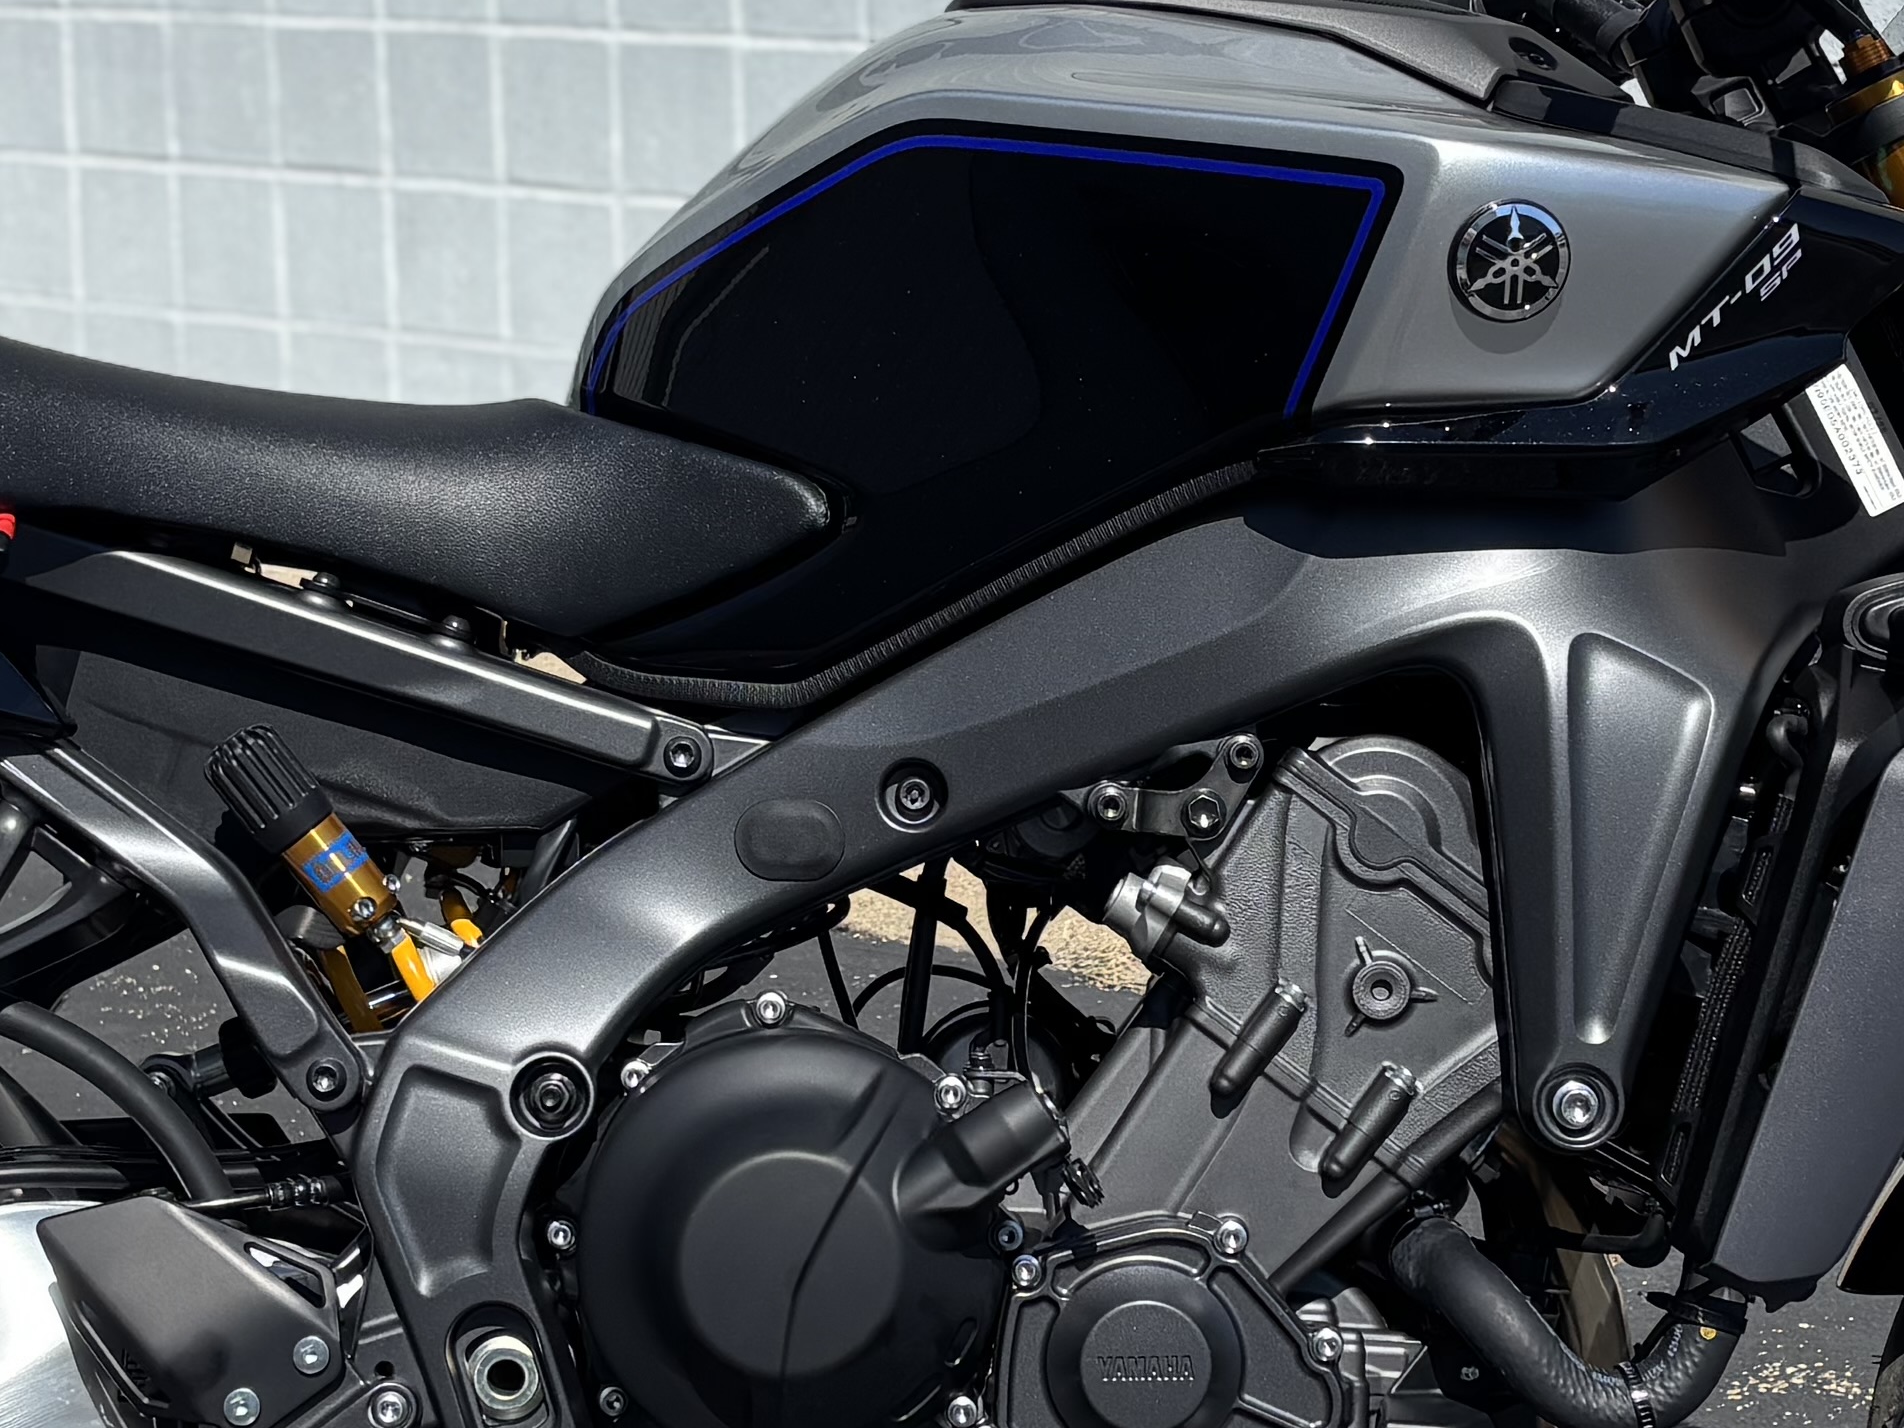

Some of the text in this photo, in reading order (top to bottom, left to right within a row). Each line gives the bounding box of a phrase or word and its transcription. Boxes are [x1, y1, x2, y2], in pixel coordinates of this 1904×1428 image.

[1669, 223, 1800, 371] MT-09
[1760, 249, 1802, 301] SP
[1097, 1355, 1195, 1382] YAMAHA
